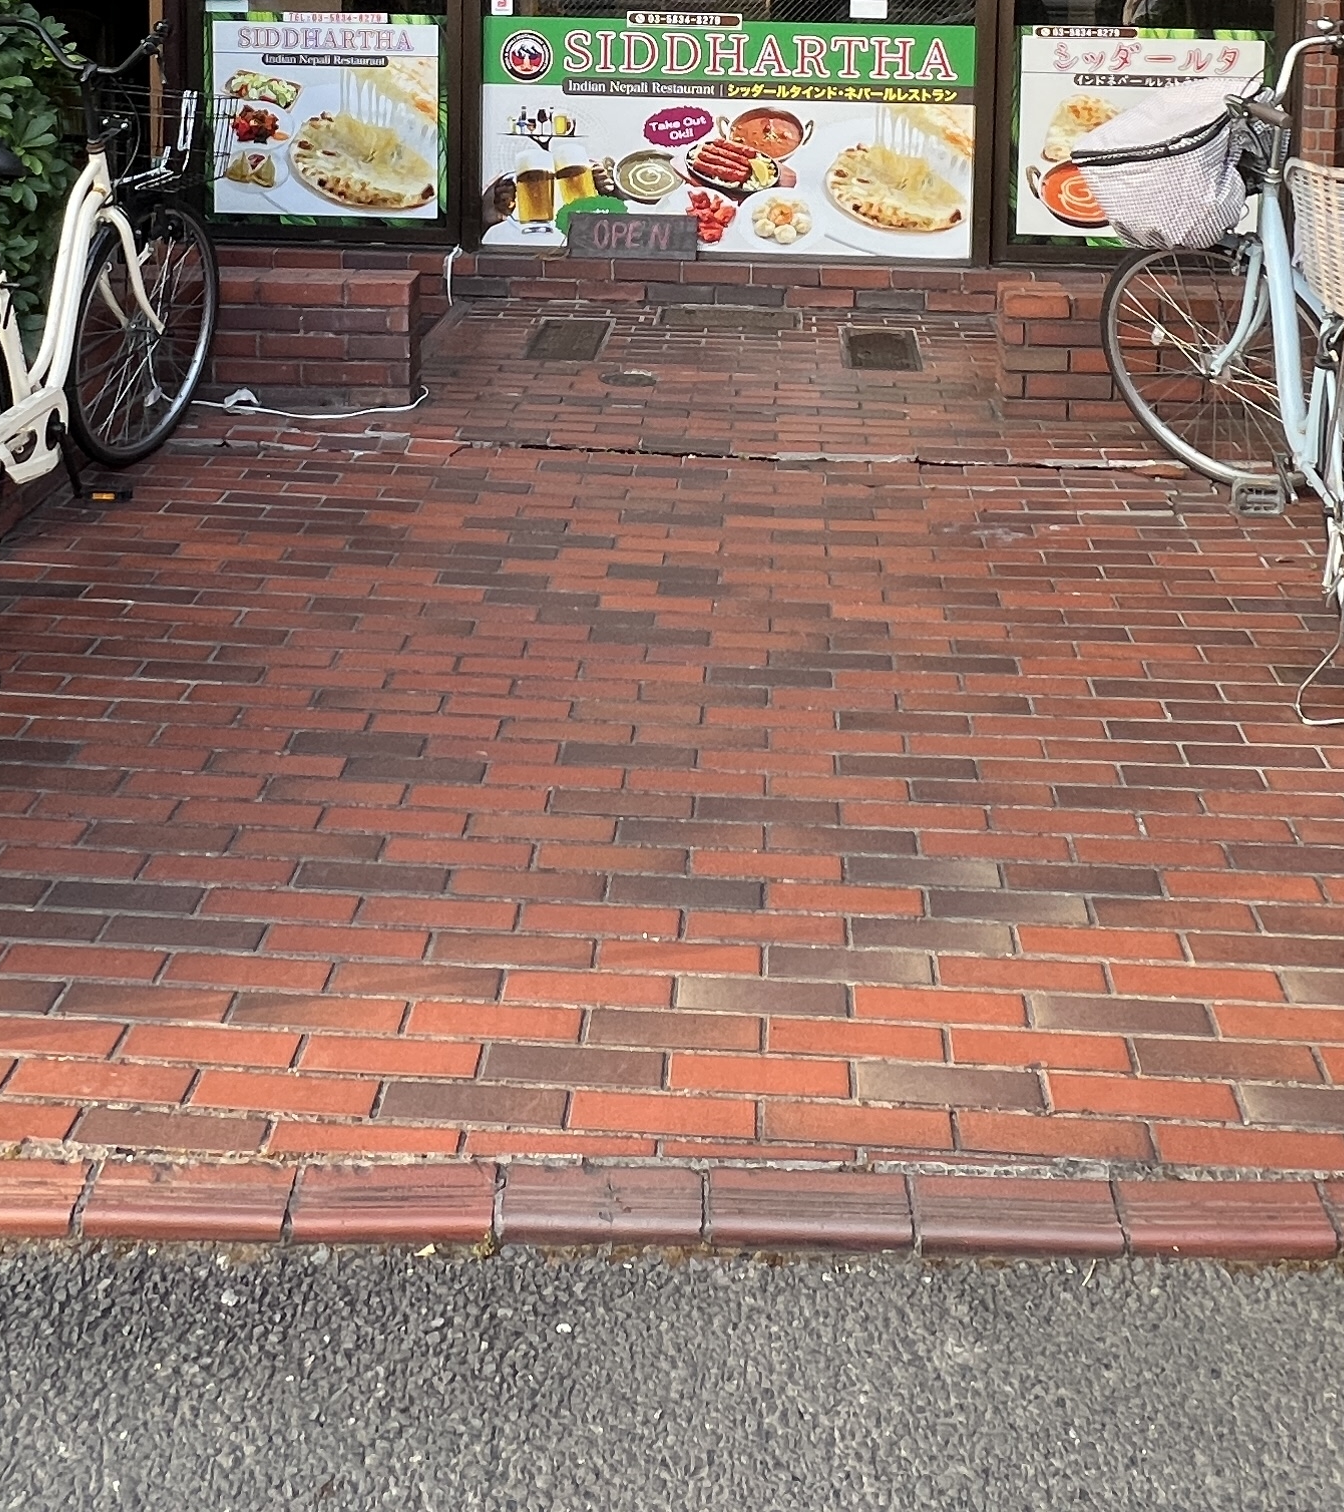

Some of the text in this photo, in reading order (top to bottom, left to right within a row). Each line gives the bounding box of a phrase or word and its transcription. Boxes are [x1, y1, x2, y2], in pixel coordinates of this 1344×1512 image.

[238, 26, 415, 52] SIDDHARTHA
[265, 54, 297, 65] Indian
[333, 56, 385, 67] Restaurant
[563, 29, 958, 81] SIDDHARTHA
[1053, 42, 1240, 75] シッダールタ
[568, 79, 715, 96] Indian Nepali Restaurant
[727, 83, 958, 102] シッダールタインド・ネパールレストラン
[649, 116, 707, 132] Take Out
[592, 219, 672, 250] OPEN
